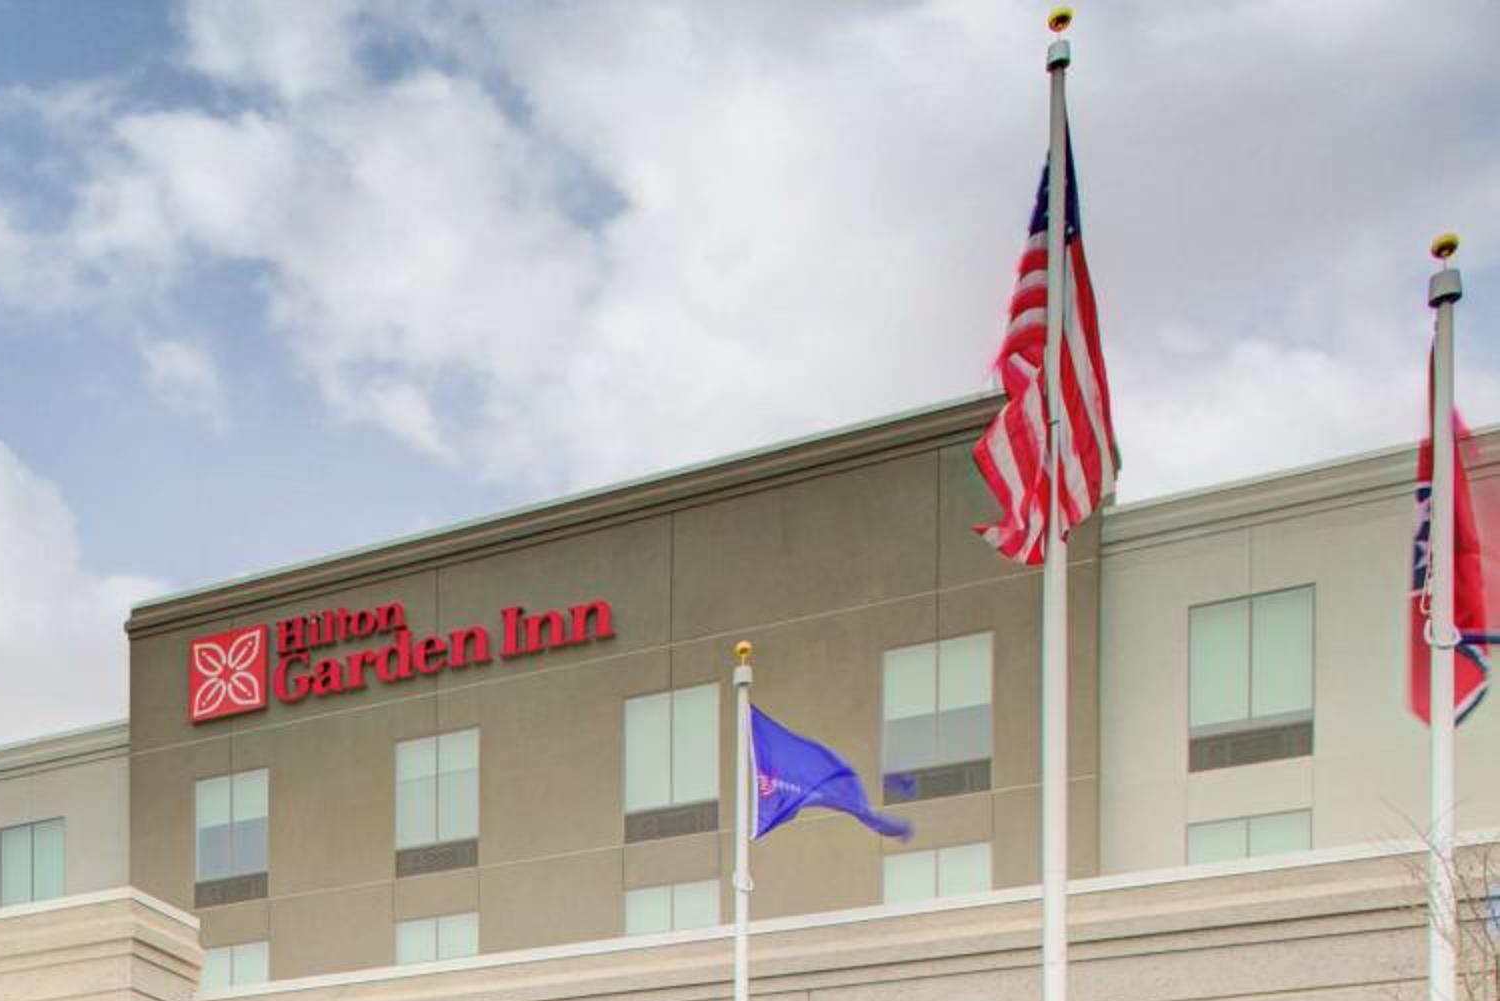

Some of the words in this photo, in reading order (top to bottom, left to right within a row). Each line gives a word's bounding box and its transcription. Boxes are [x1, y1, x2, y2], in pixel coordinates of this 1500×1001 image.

[274, 624, 491, 702] Garden
[501, 599, 614, 656] Inn
[275, 602, 406, 653] Hilton
